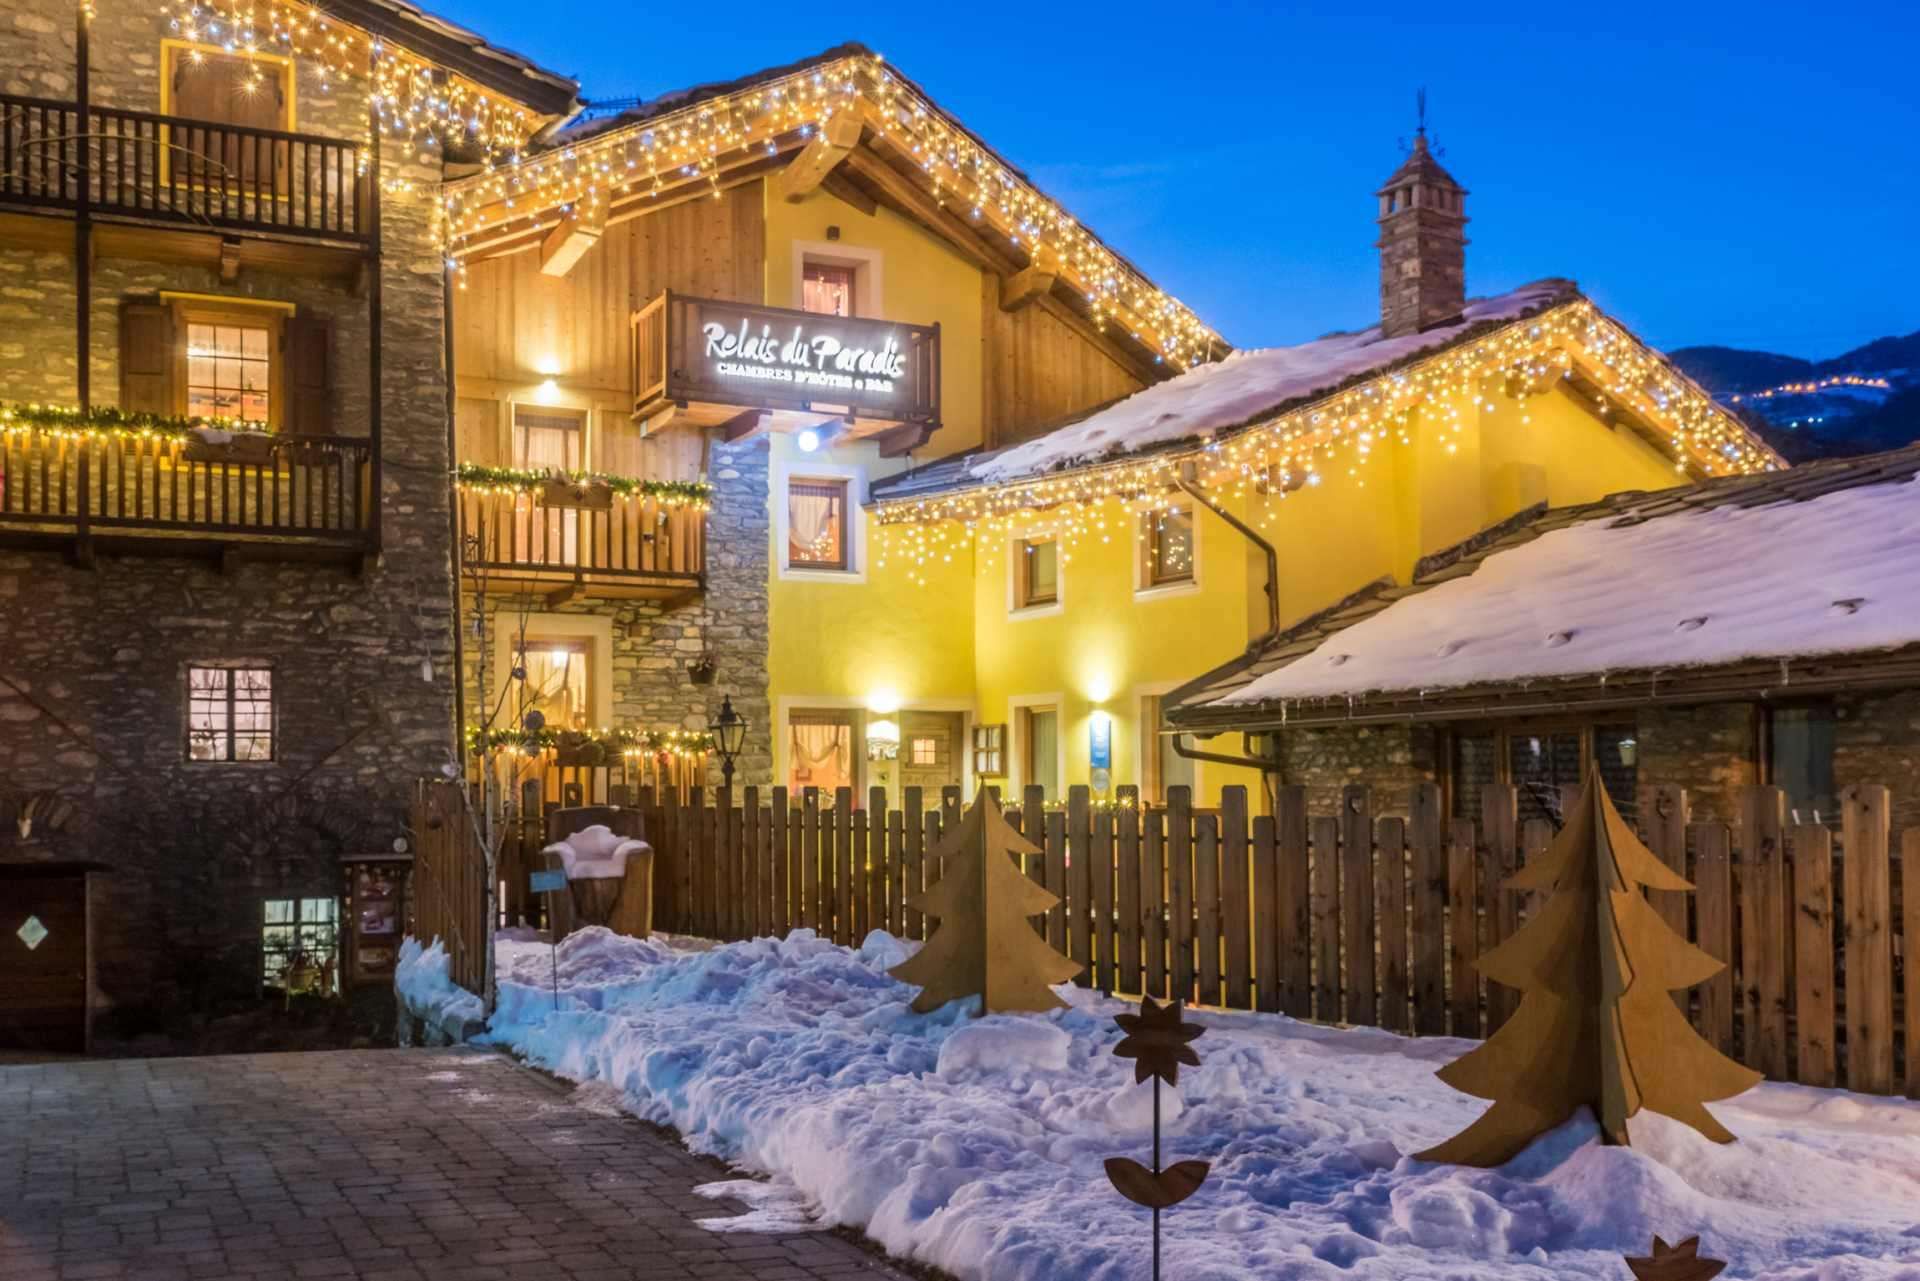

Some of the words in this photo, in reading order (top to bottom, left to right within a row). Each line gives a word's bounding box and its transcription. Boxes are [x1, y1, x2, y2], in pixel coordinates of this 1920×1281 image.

[703, 318, 780, 364] Relais
[781, 326, 811, 368] du
[811, 335, 907, 379] Paradis
[717, 362, 793, 382] CHAMBRES
